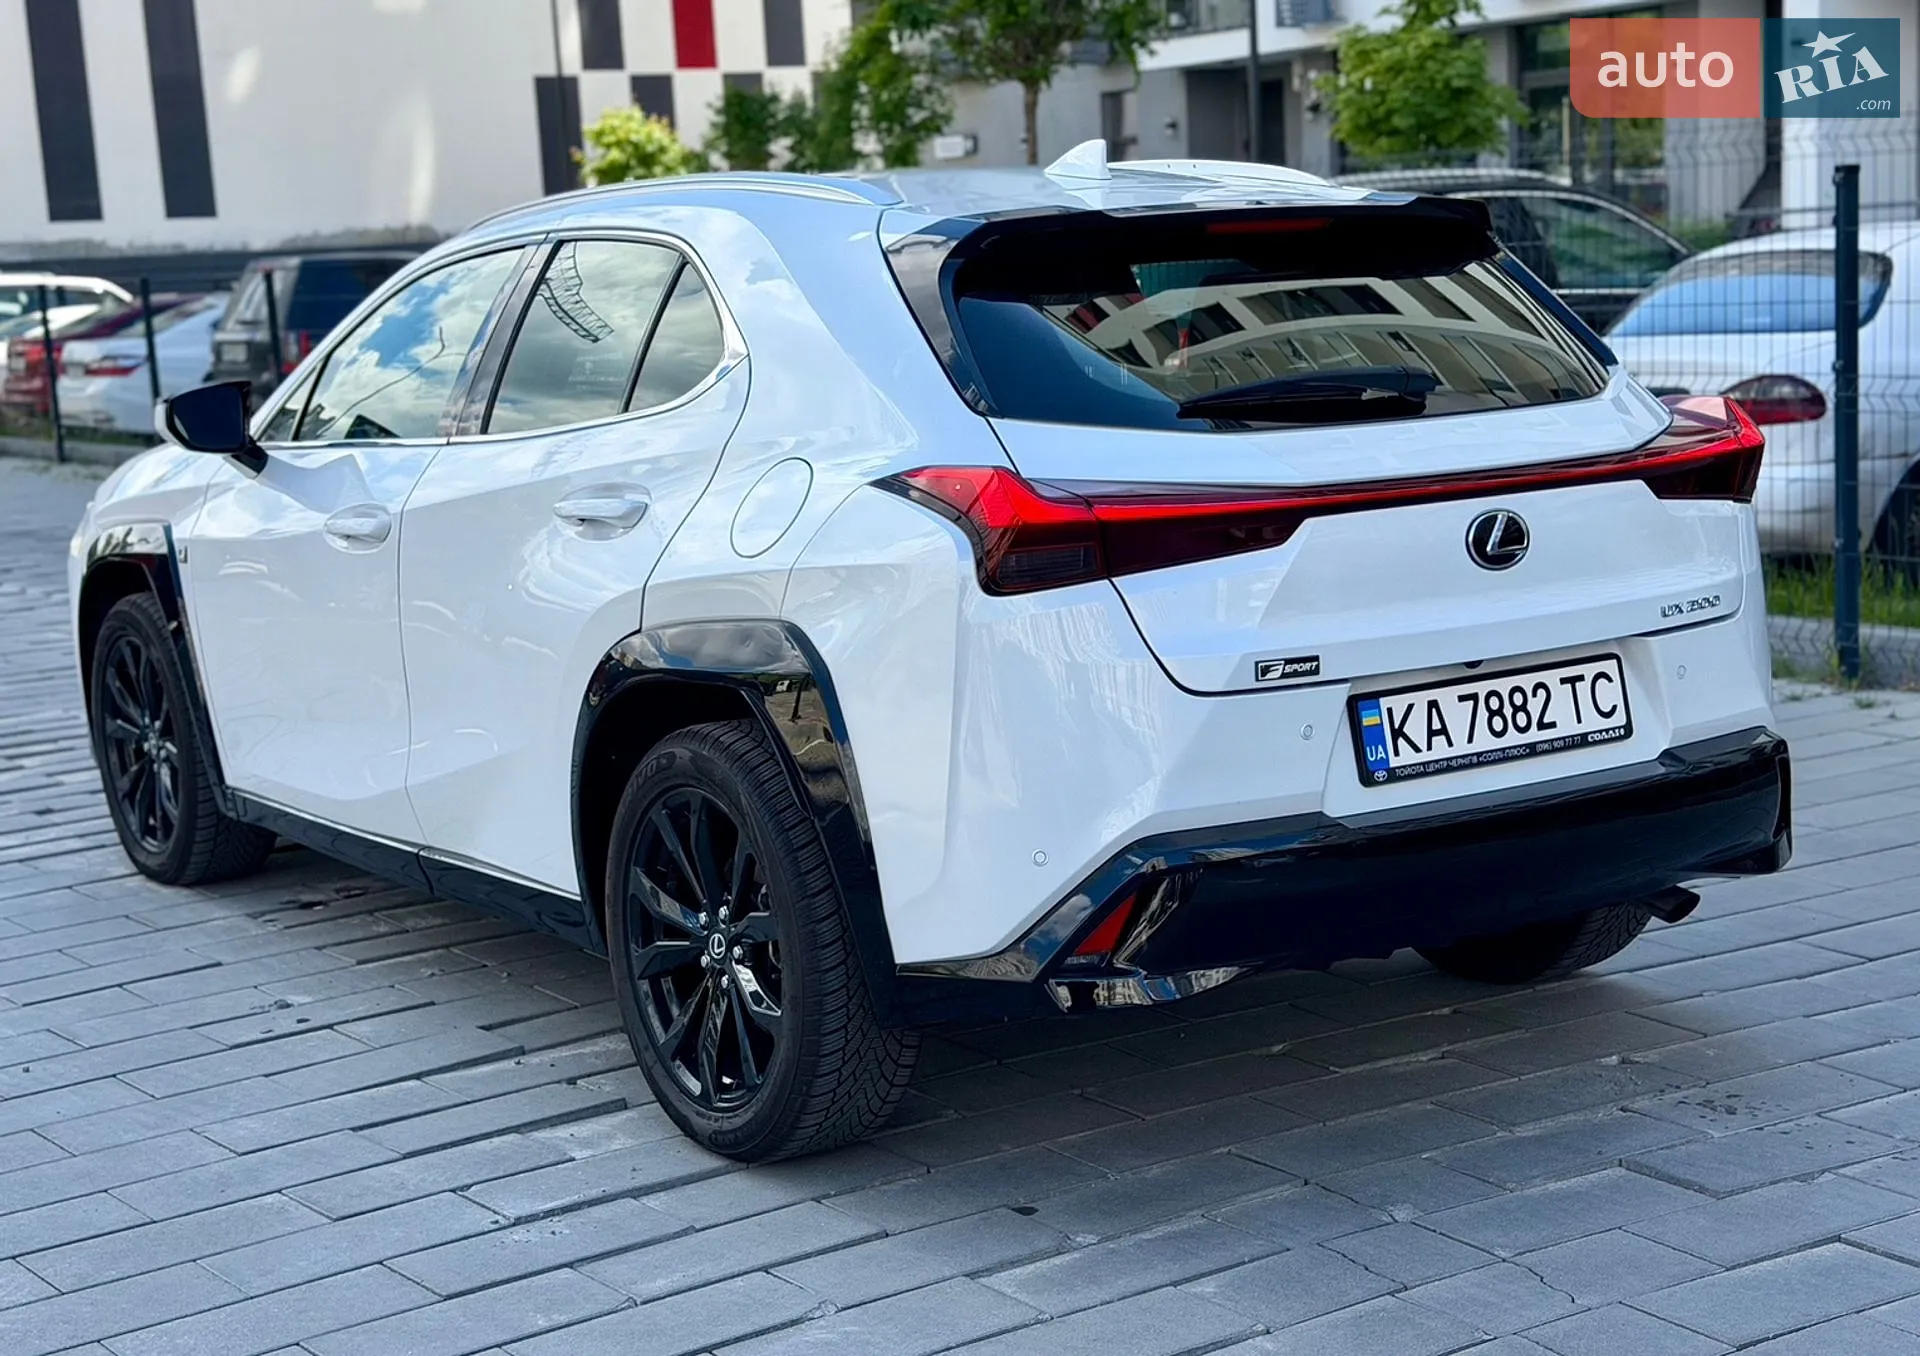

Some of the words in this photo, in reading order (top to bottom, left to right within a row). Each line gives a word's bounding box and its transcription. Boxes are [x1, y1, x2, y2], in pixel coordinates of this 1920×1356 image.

[1660, 602, 1684, 618] UX
[1284, 661, 1319, 673] SPORT
[1386, 699, 1454, 758] KA
[1457, 681, 1558, 745] 7882
[1559, 671, 1618, 725] TC
[1366, 744, 1387, 762] UA
